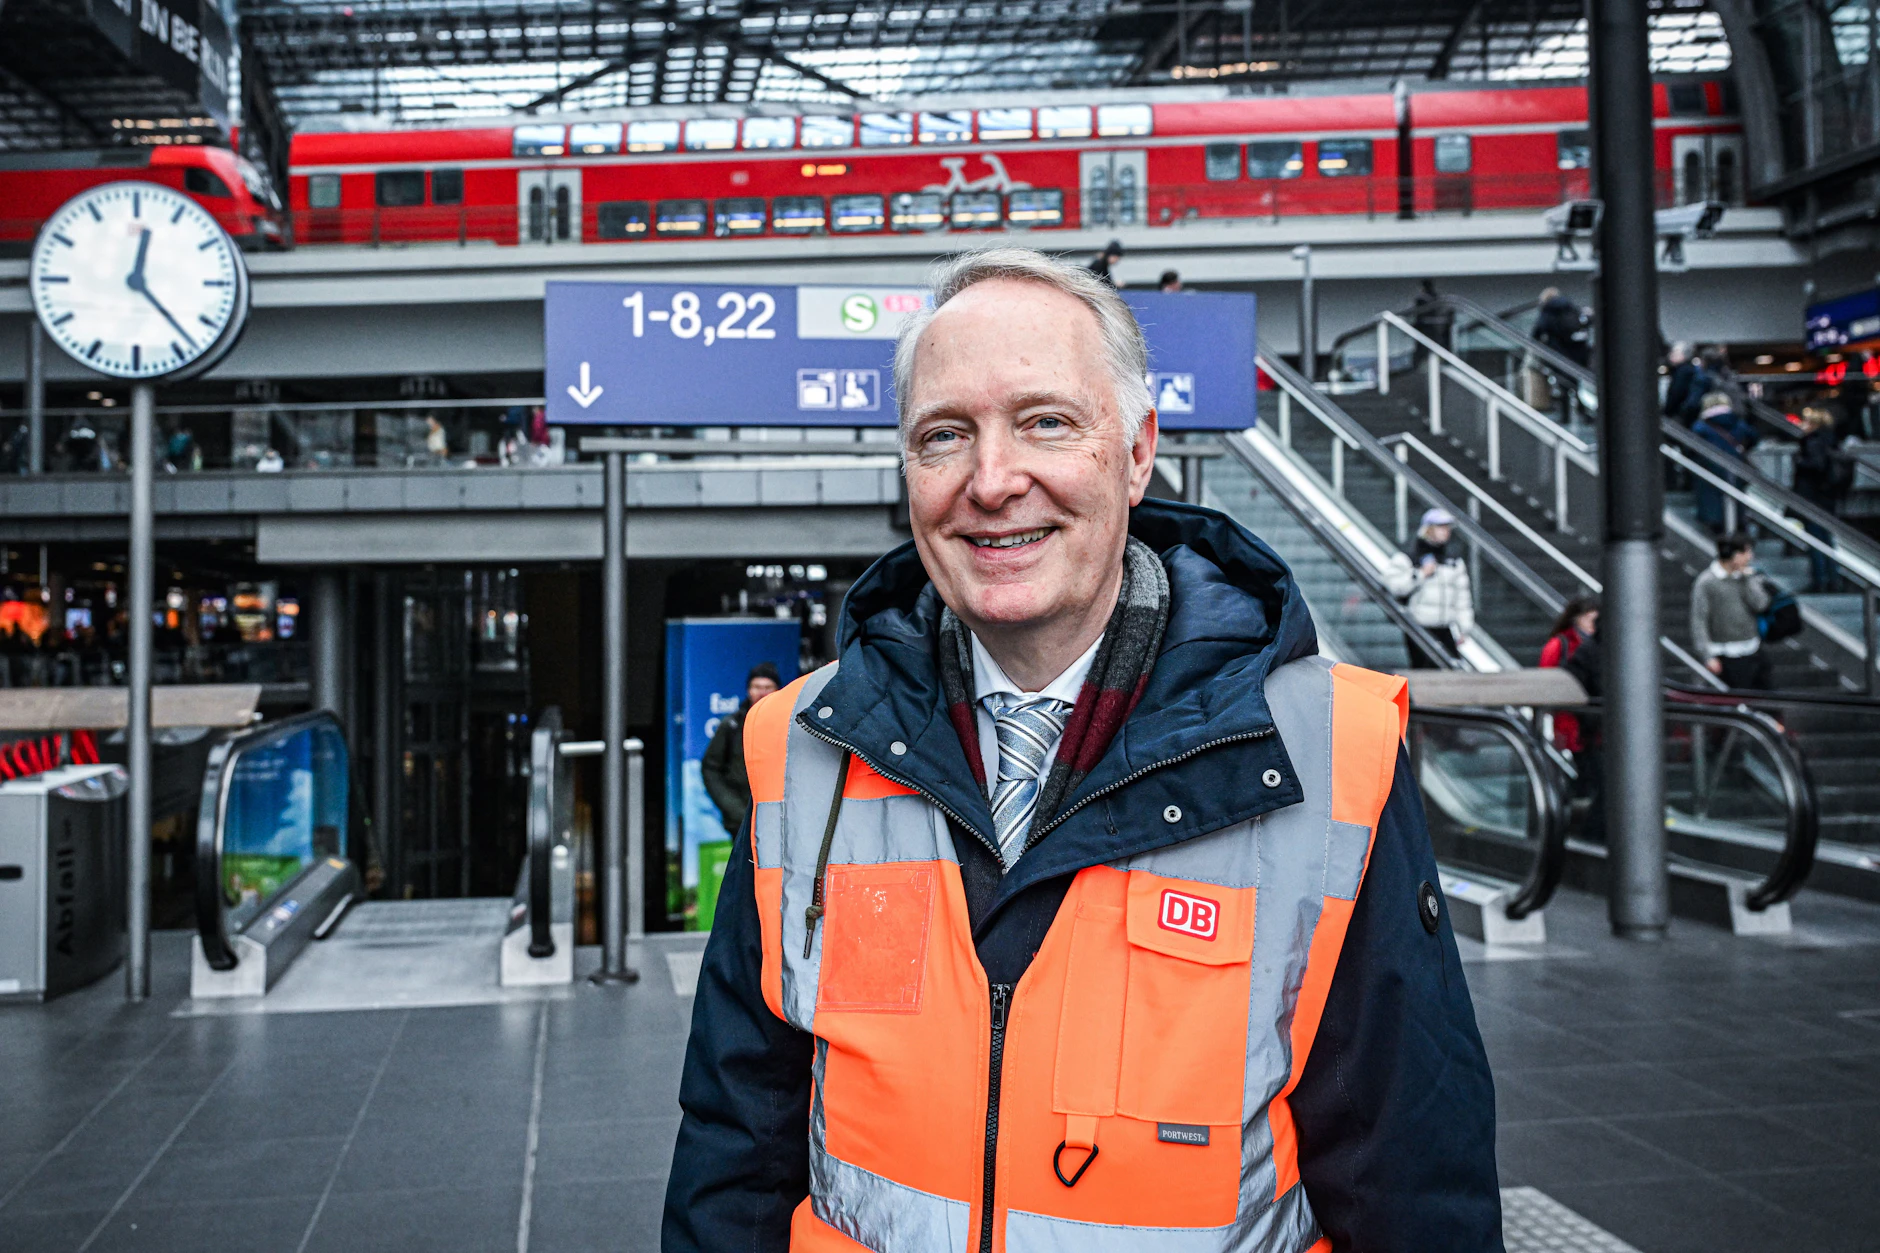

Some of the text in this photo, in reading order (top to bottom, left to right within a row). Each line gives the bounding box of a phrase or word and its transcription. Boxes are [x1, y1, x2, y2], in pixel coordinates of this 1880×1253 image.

[623, 291, 776, 346] 1-8,22
[844, 296, 876, 332] S
[1166, 895, 1213, 933] DB
